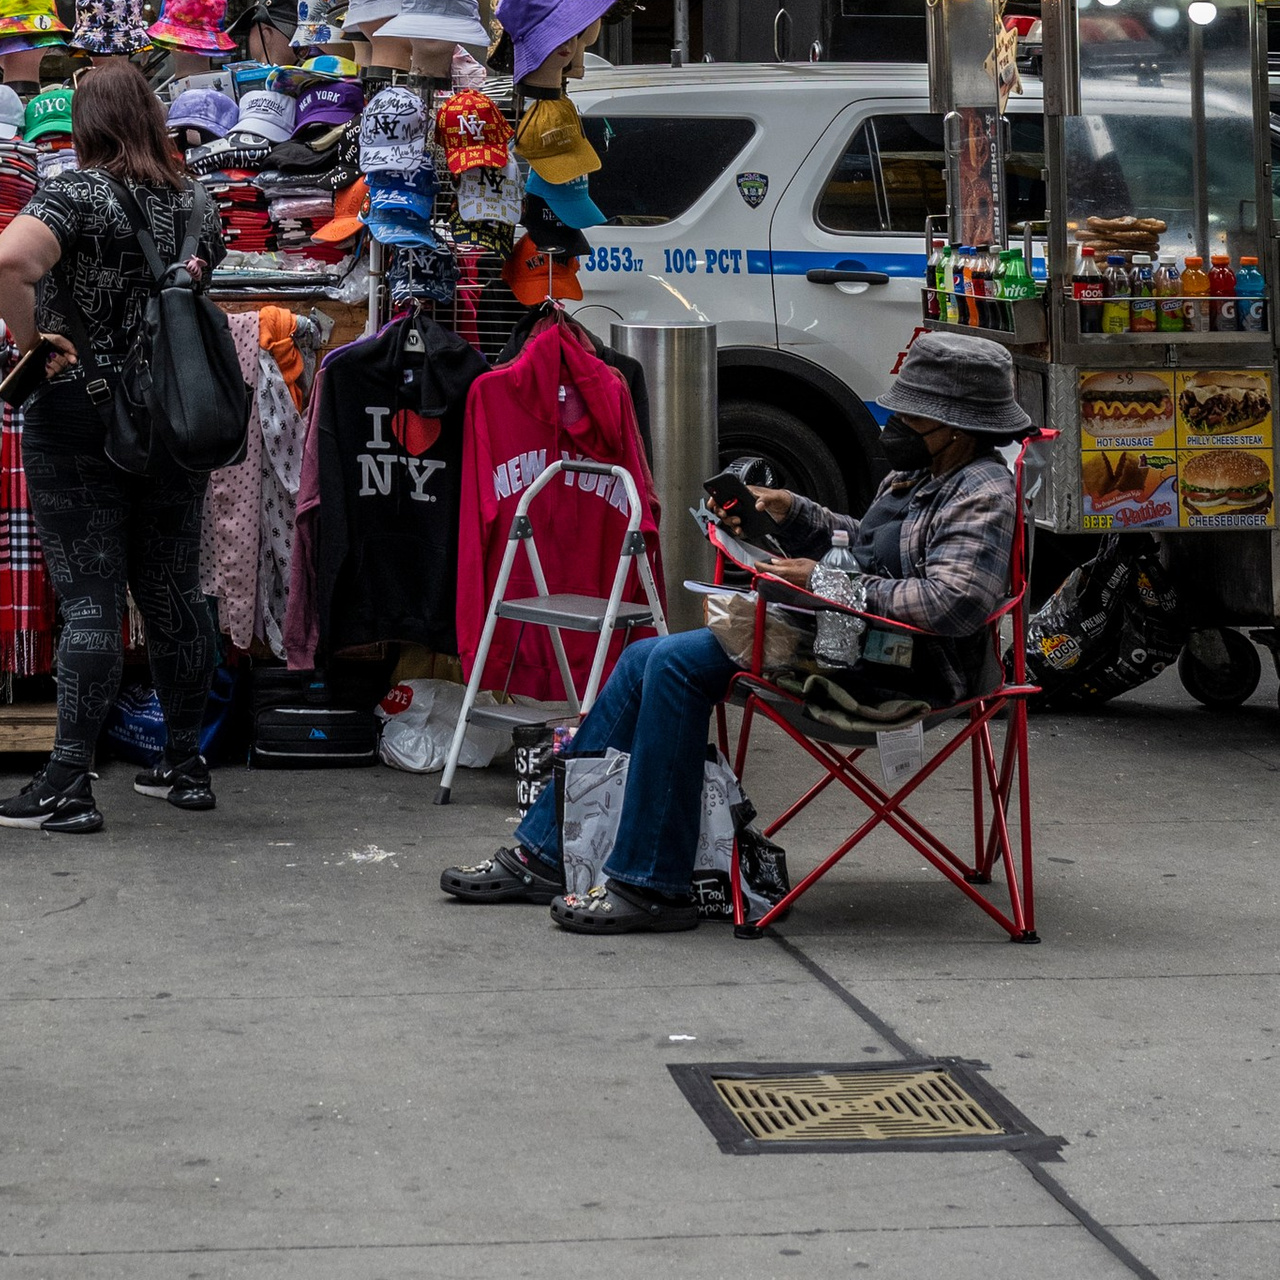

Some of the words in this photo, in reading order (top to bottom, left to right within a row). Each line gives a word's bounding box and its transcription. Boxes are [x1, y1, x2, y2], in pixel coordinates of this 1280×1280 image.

[34, 97, 66, 117] NYC
[299, 95, 312, 112] NEW
[316, 90, 341, 103] YORK
[345, 125, 361, 140] NYC
[369, 115, 400, 140] NY
[457, 115, 486, 140] NY
[344, 144, 358, 162] NYC
[330, 171, 348, 185] NYC
[477, 167, 506, 194] NY
[990, 142, 999, 202] CHEESE
[993, 206, 1001, 246] PRET
[525, 255, 545, 270] NEW
[585, 247, 633, 272] 3853
[663, 248, 693, 274] 100
[705, 249, 741, 274] PCT
[1004, 283, 1028, 297] rite
[1183, 301, 1195, 318] G
[1221, 301, 1235, 319] G
[1250, 301, 1263, 318] G
[365, 406, 391, 449] I
[1096, 437, 1113, 447] HOT
[1114, 436, 1154, 447] SAUSAGE
[1187, 435, 1211, 445] PHILLY
[1212, 435, 1239, 445] CHEESE
[1240, 435, 1263, 445] STEAK
[356, 453, 446, 502] NY
[493, 449, 547, 501] NEW
[561, 450, 630, 518] YORK
[1083, 514, 1114, 529] BEEF
[1115, 500, 1172, 527] Patties
[1188, 515, 1267, 527] CHEESEBURGER
[1080, 611, 1108, 632] PREMIU
[1047, 639, 1078, 666] FOGO
[387, 688, 408, 705] OVE
[515, 747, 541, 774] SE
